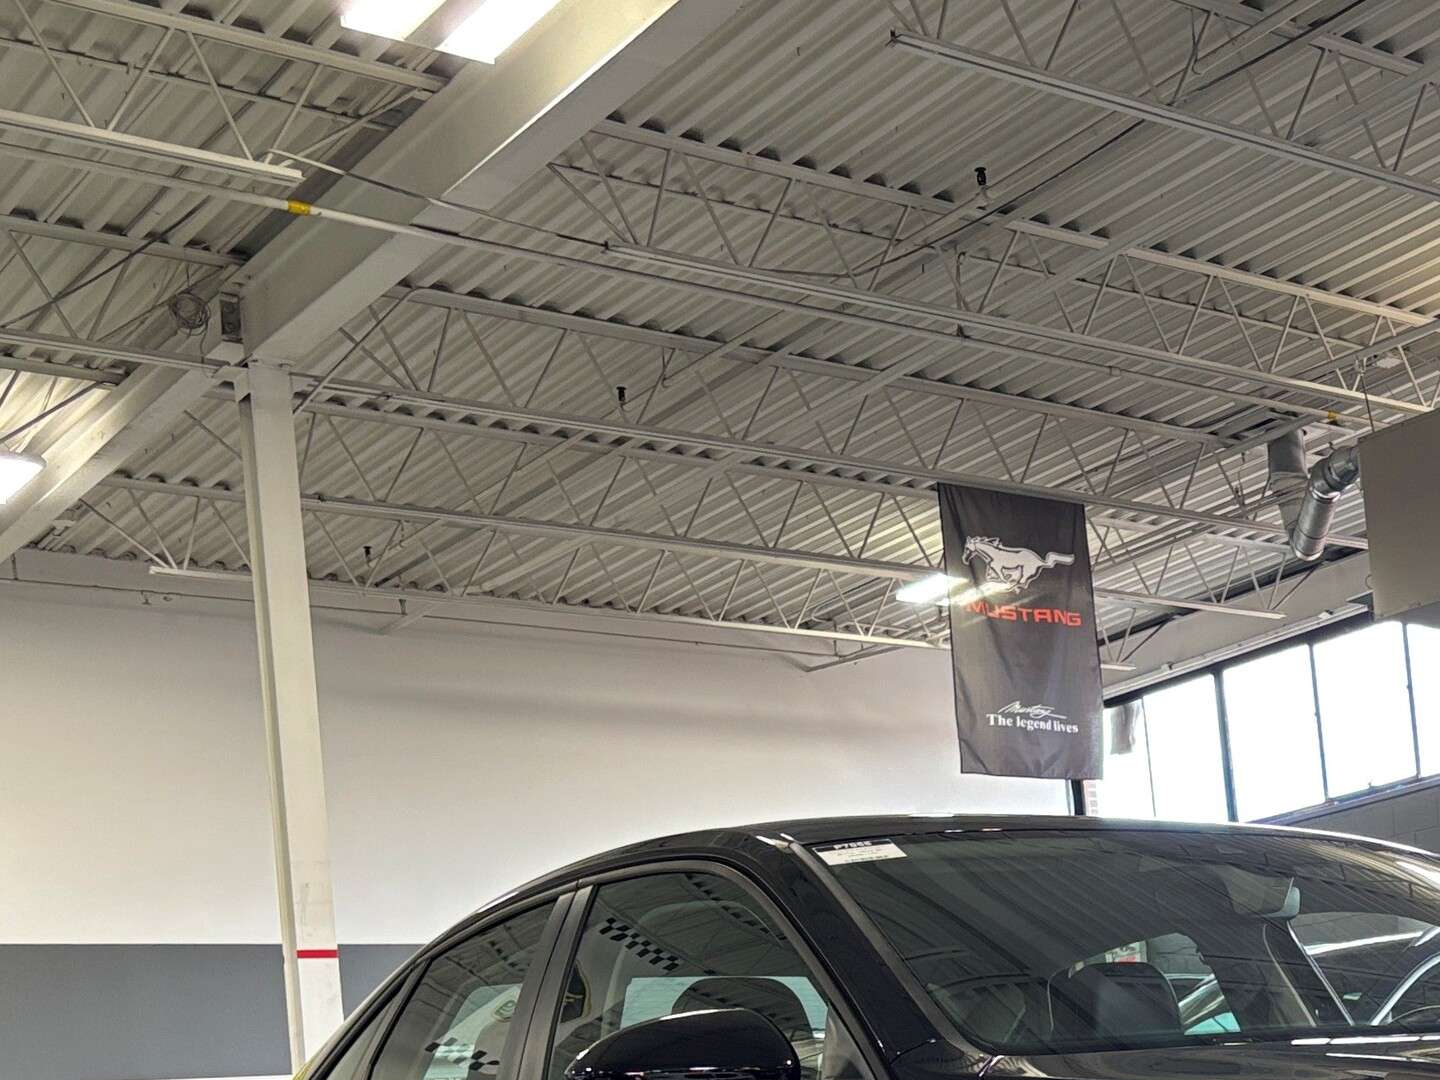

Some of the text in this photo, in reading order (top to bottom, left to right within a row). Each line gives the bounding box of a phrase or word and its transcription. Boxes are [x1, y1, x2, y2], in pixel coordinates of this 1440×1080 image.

[966, 601, 1082, 626] MUSTANG
[986, 713, 1079, 733] The legend lives
